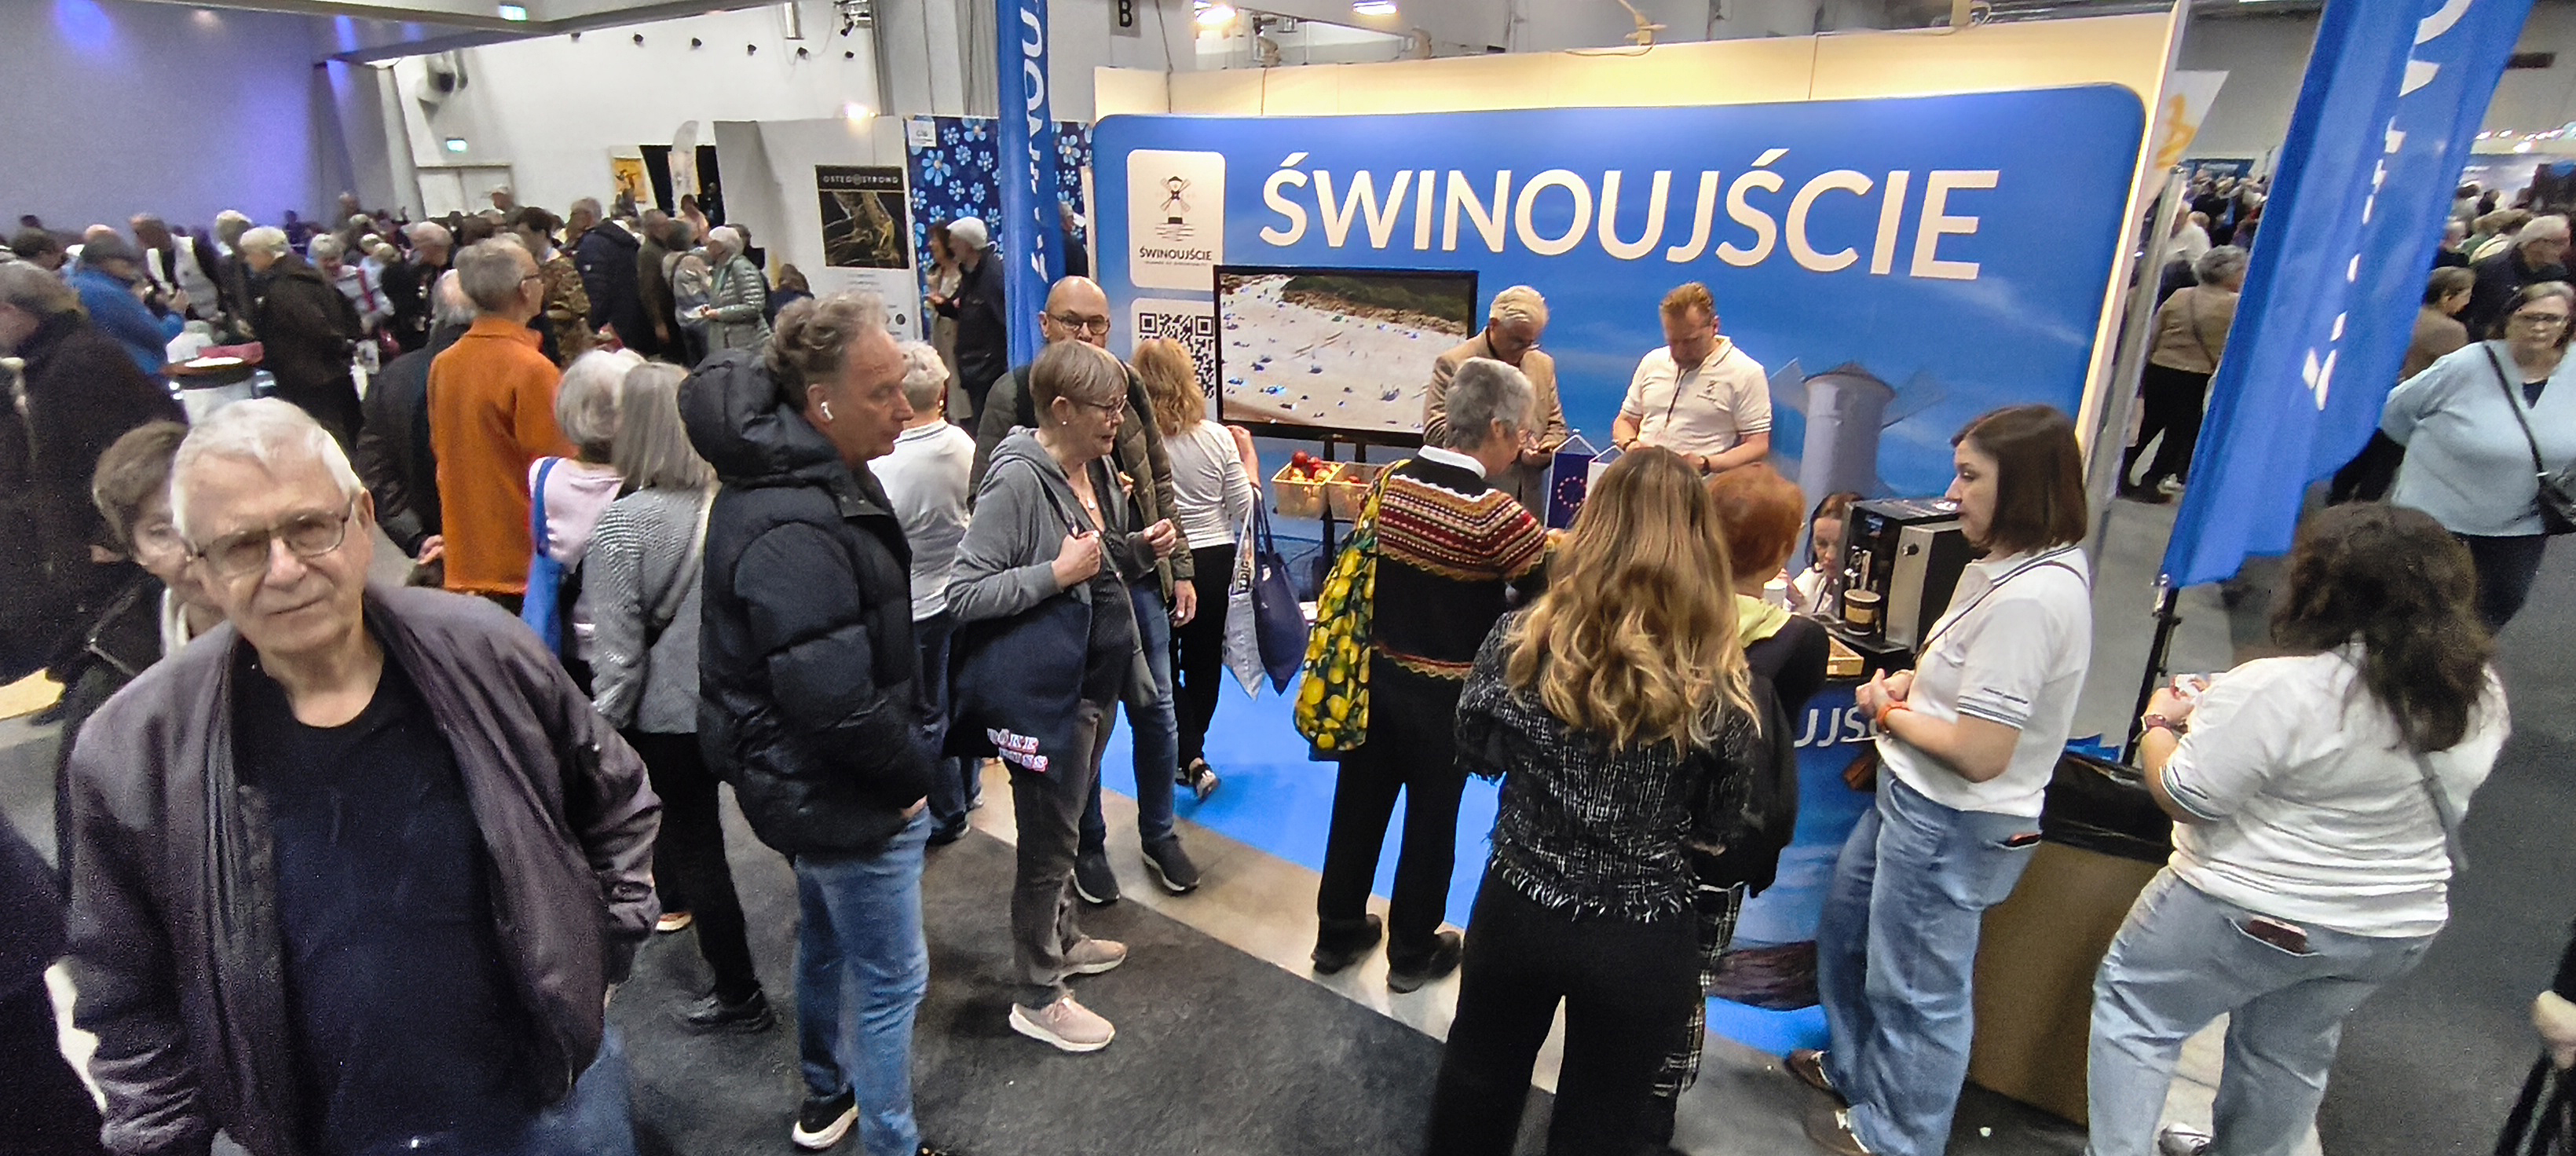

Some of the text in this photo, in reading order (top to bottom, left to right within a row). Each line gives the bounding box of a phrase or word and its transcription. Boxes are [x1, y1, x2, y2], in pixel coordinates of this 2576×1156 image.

[1118, 0, 1132, 27] B
[1259, 148, 2001, 280] ŚWINOUJŚCIE
[1139, 245, 1213, 261] ŚWINOUJŚCIE
